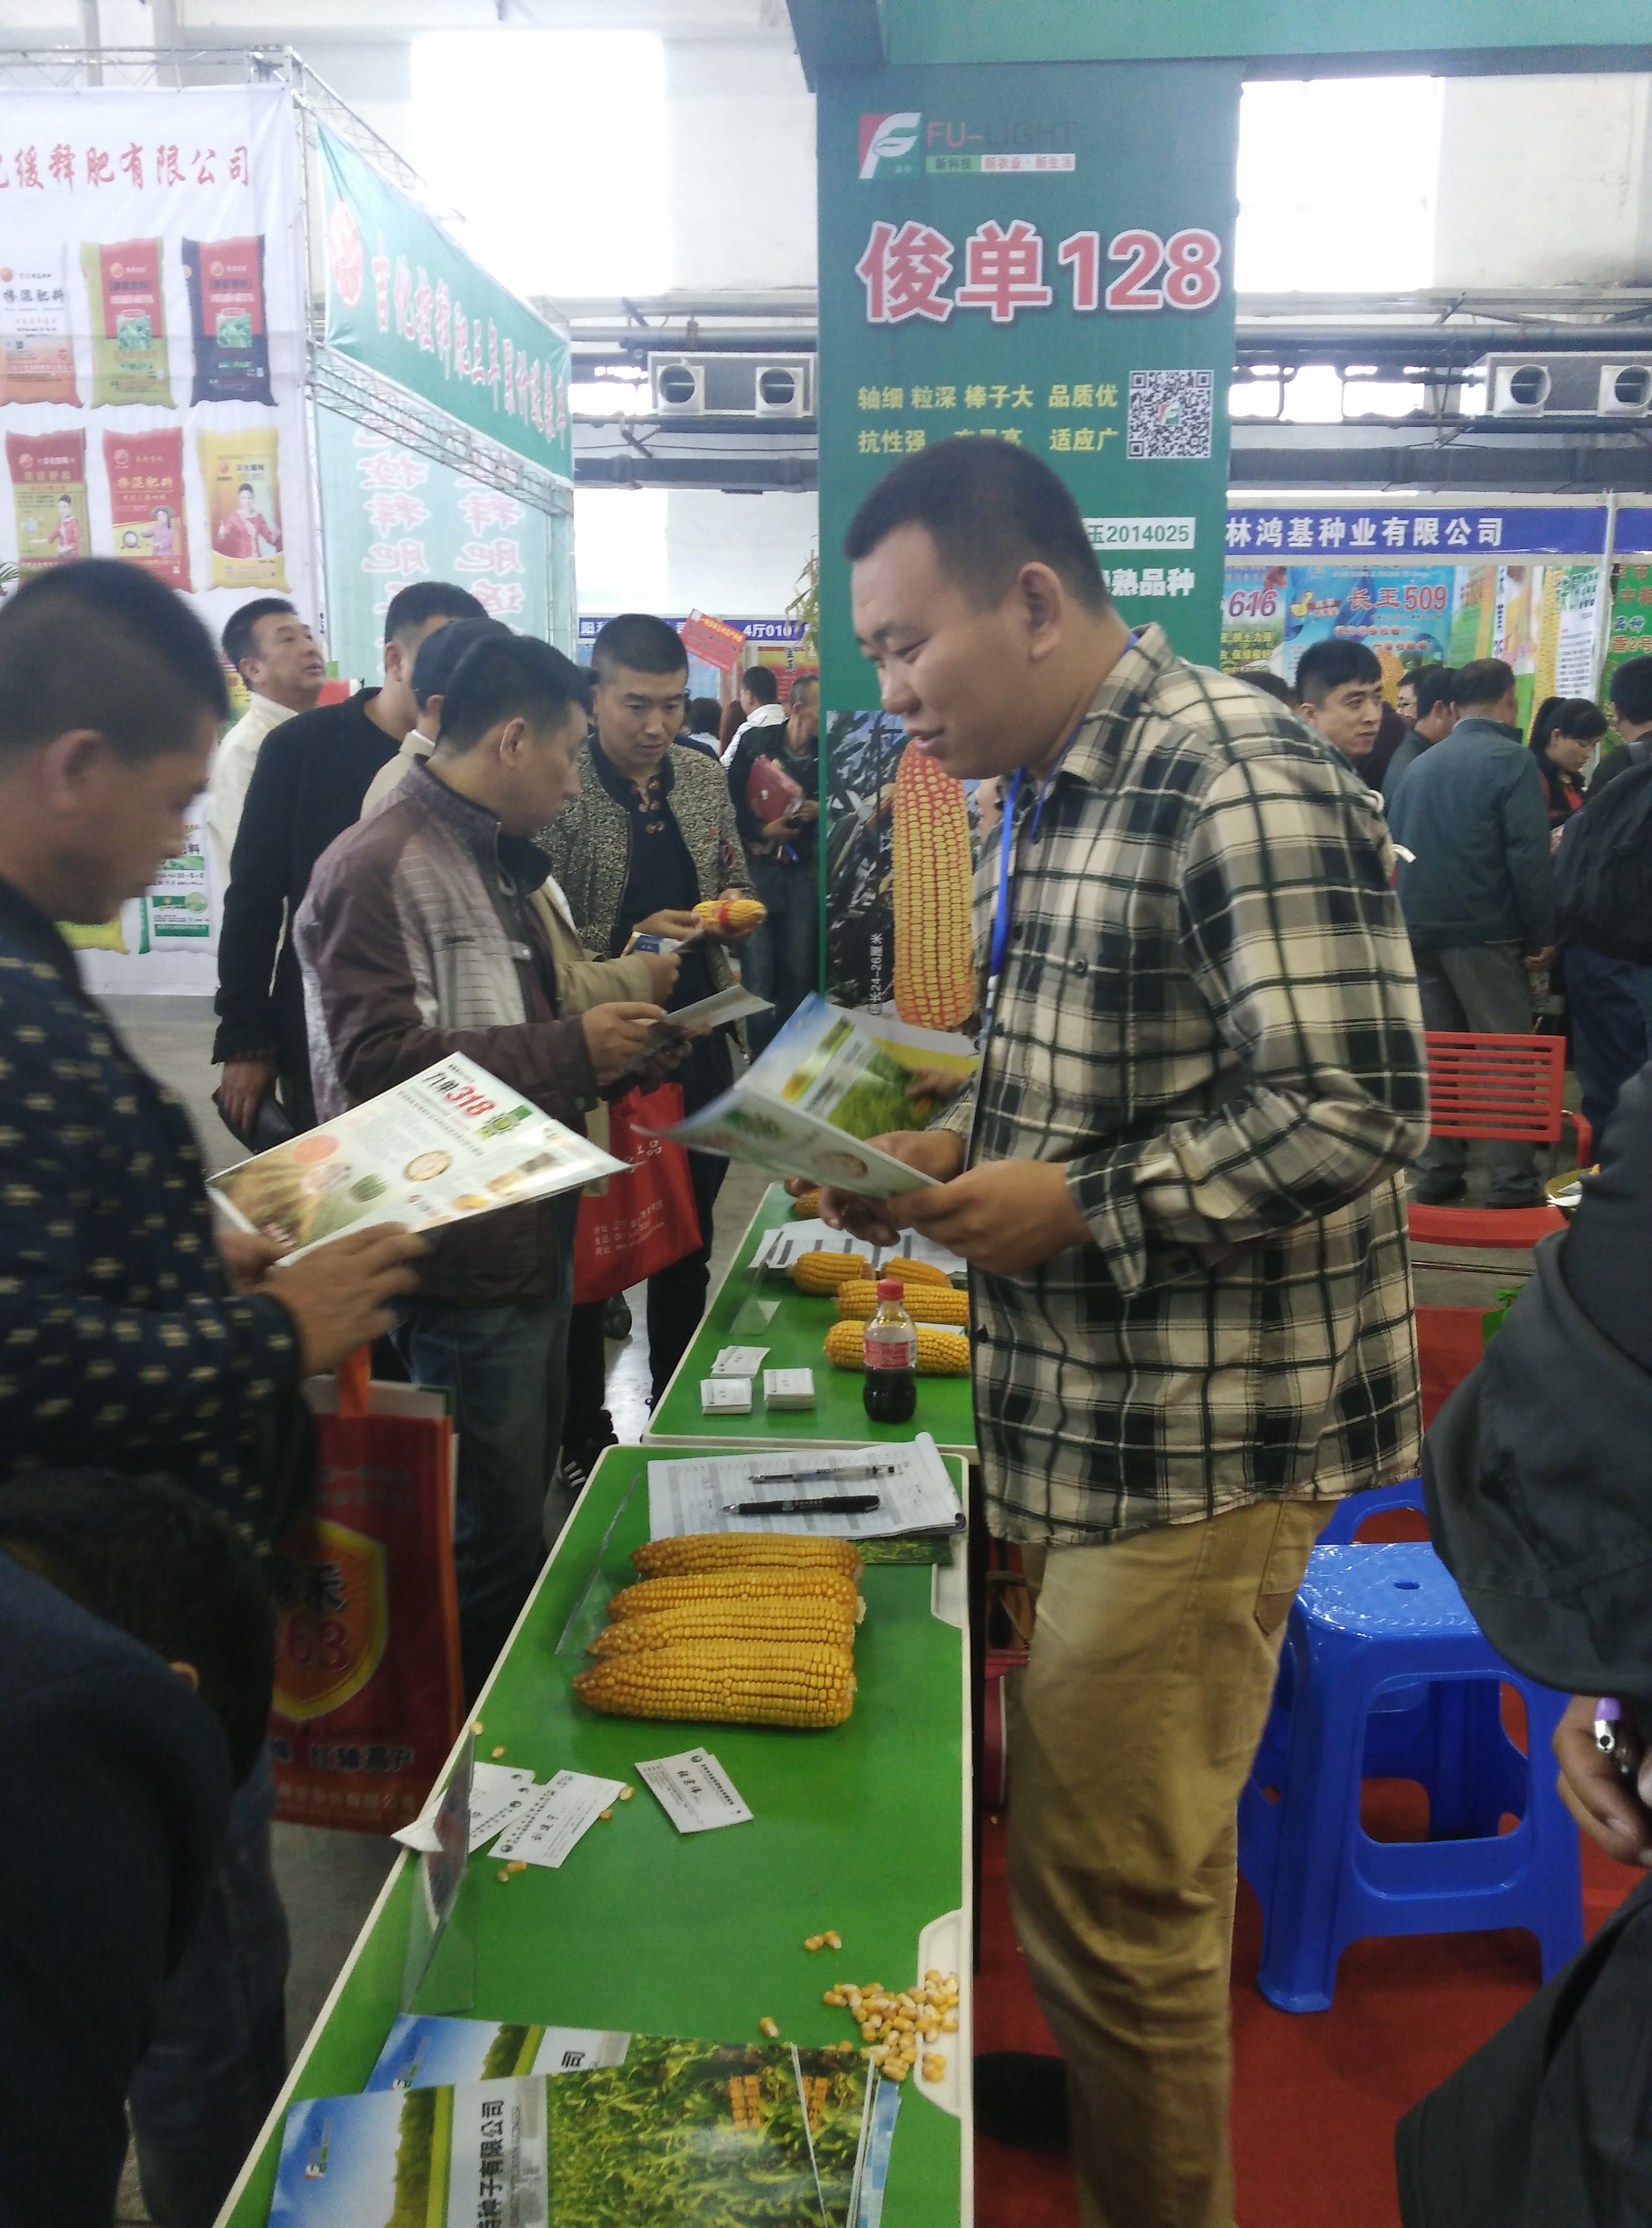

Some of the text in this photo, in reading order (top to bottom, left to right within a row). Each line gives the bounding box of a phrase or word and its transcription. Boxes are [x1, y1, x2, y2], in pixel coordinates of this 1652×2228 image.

[855, 219, 1222, 324] 俊单128
[857, 384, 1118, 409] 轴细 粒深 棒子大 品质优
[857, 429, 927, 453] 抗性强
[1049, 428, 1119, 453] 适应广
[1226, 516, 1504, 547] 林鸿基种业有限公司
[1101, 567, 1196, 597] 熟品种
